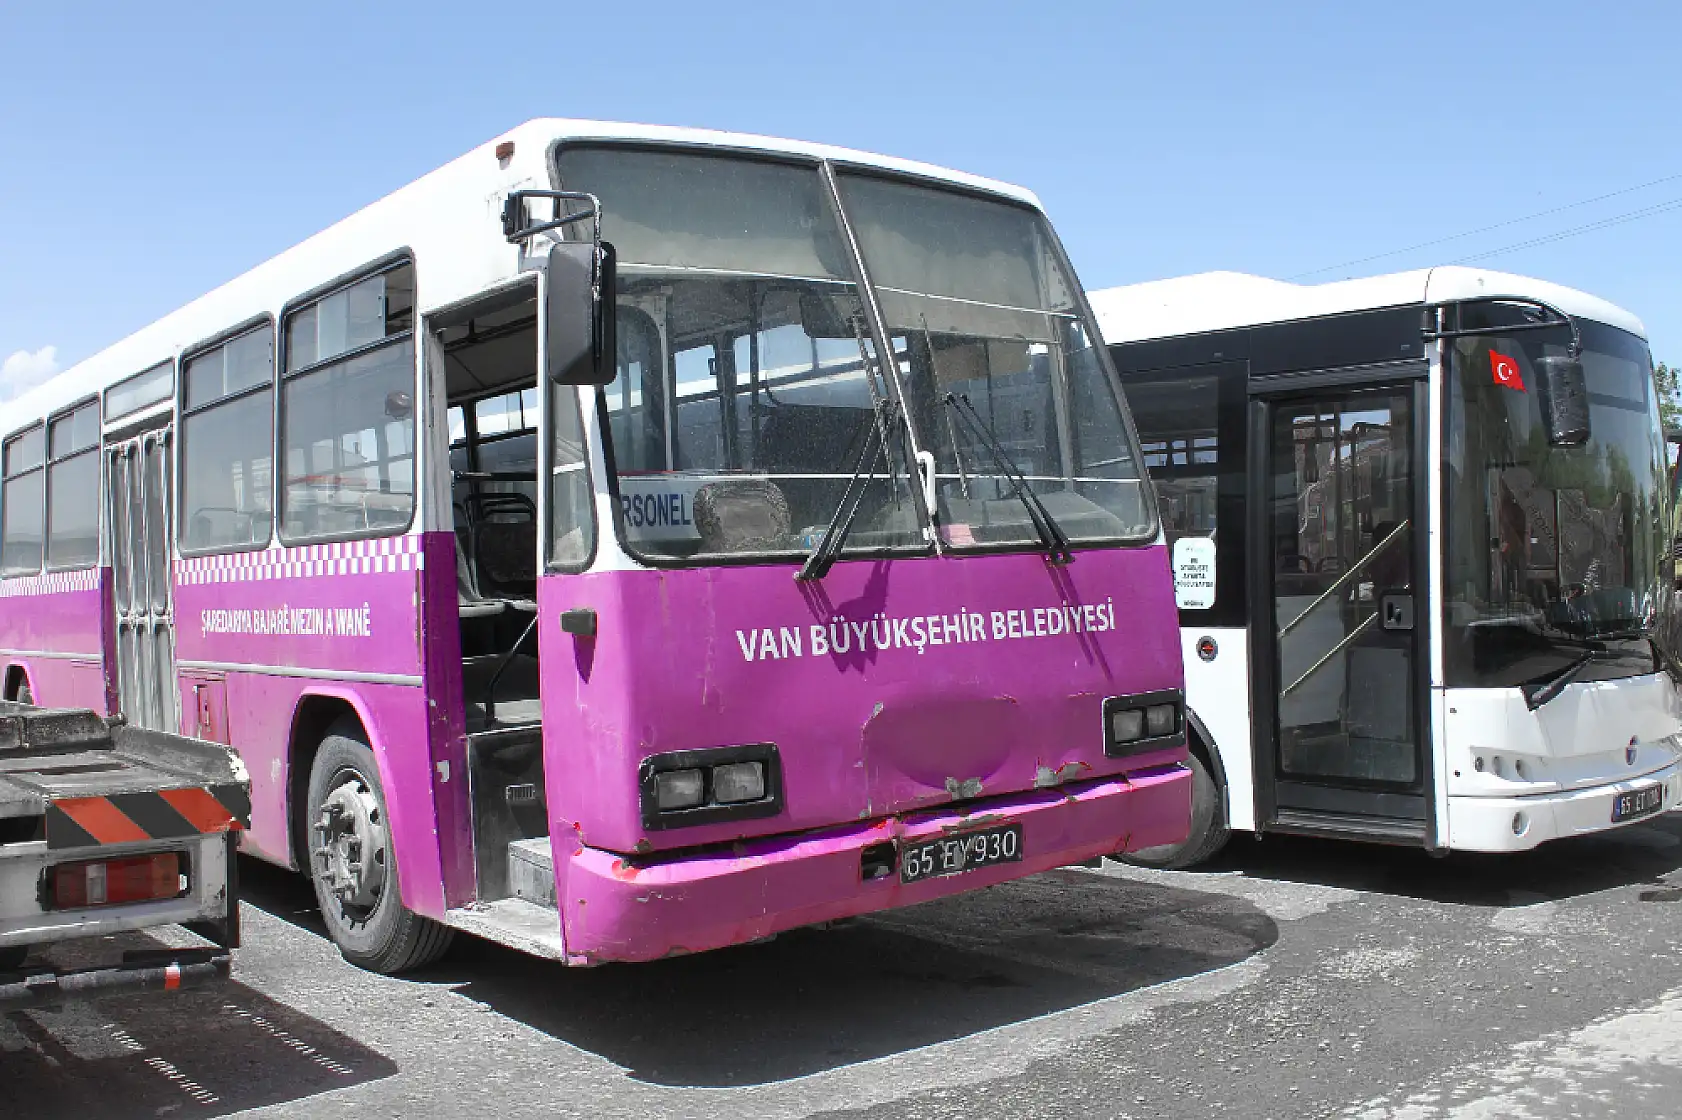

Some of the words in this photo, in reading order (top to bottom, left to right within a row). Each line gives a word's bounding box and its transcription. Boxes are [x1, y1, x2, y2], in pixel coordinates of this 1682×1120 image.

[253, 604, 290, 634] BAJARÊ
[291, 608, 324, 635] MEZIN
[325, 608, 334, 636] A
[335, 601, 371, 636] WANÊ
[736, 626, 802, 661] VAN
[810, 606, 987, 656] BÜYÜKŞEHİR
[991, 597, 1116, 640] BELEDİYESİ
[905, 845, 934, 877] 65
[975, 830, 1017, 862] 930
